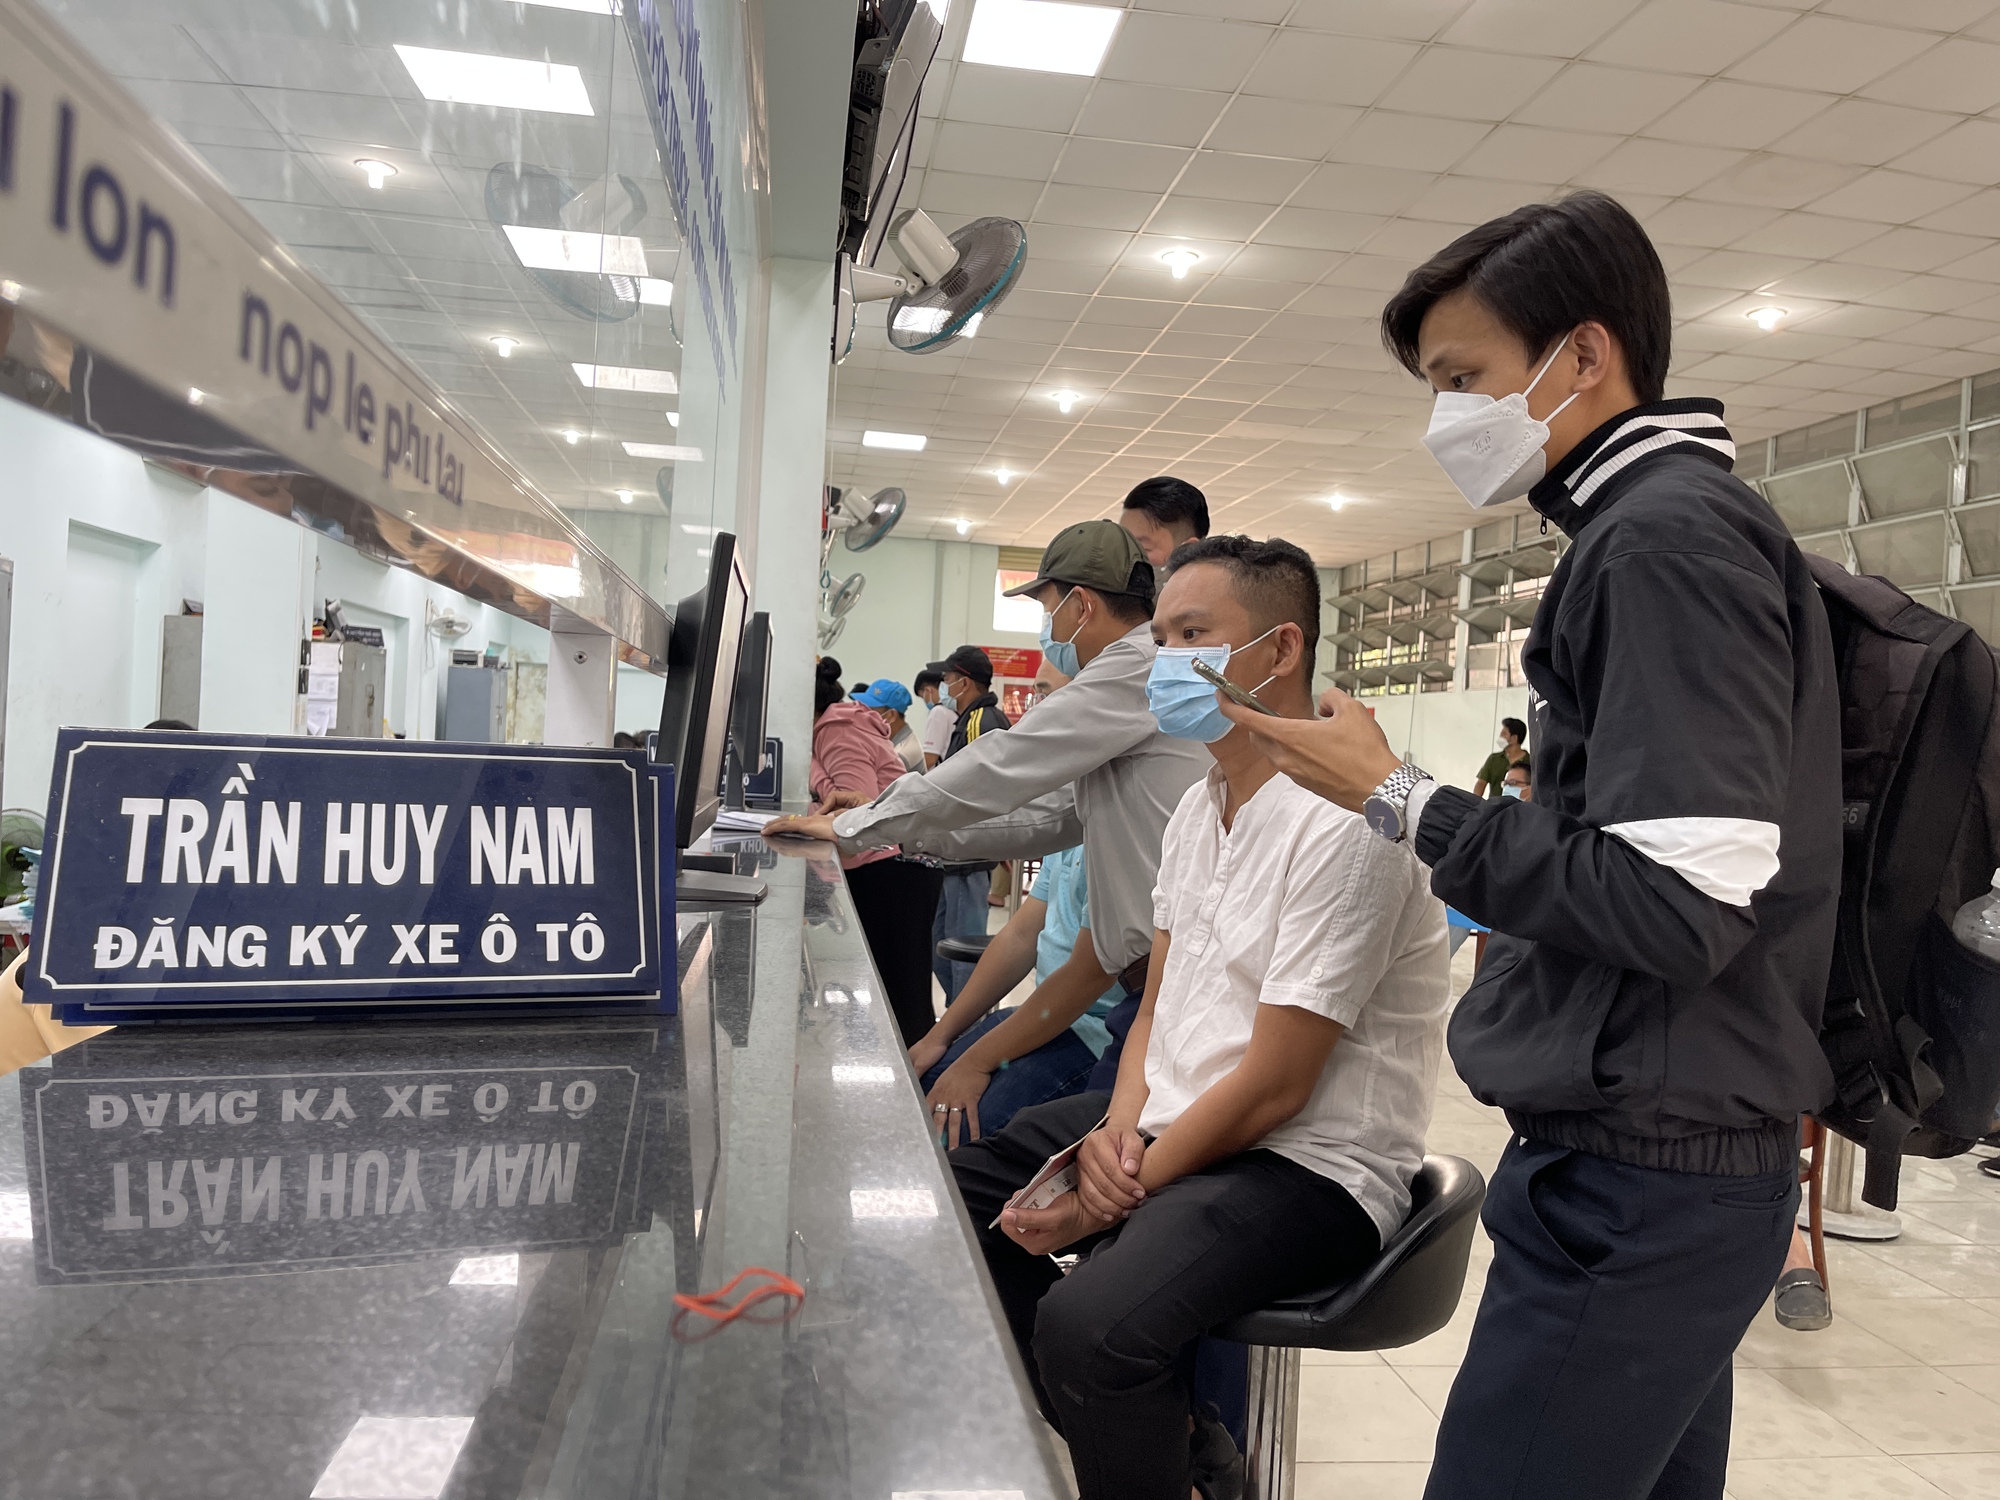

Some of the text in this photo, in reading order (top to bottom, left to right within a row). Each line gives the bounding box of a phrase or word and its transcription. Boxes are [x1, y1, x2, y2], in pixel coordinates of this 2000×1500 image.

[52, 98, 178, 308] lon
[240, 287, 333, 432] nop
[344, 349, 377, 445] le
[120, 762, 595, 886] TRẦN HUY NAM
[93, 912, 606, 969] ĐĂNG KÝ XE Ô TÔ
